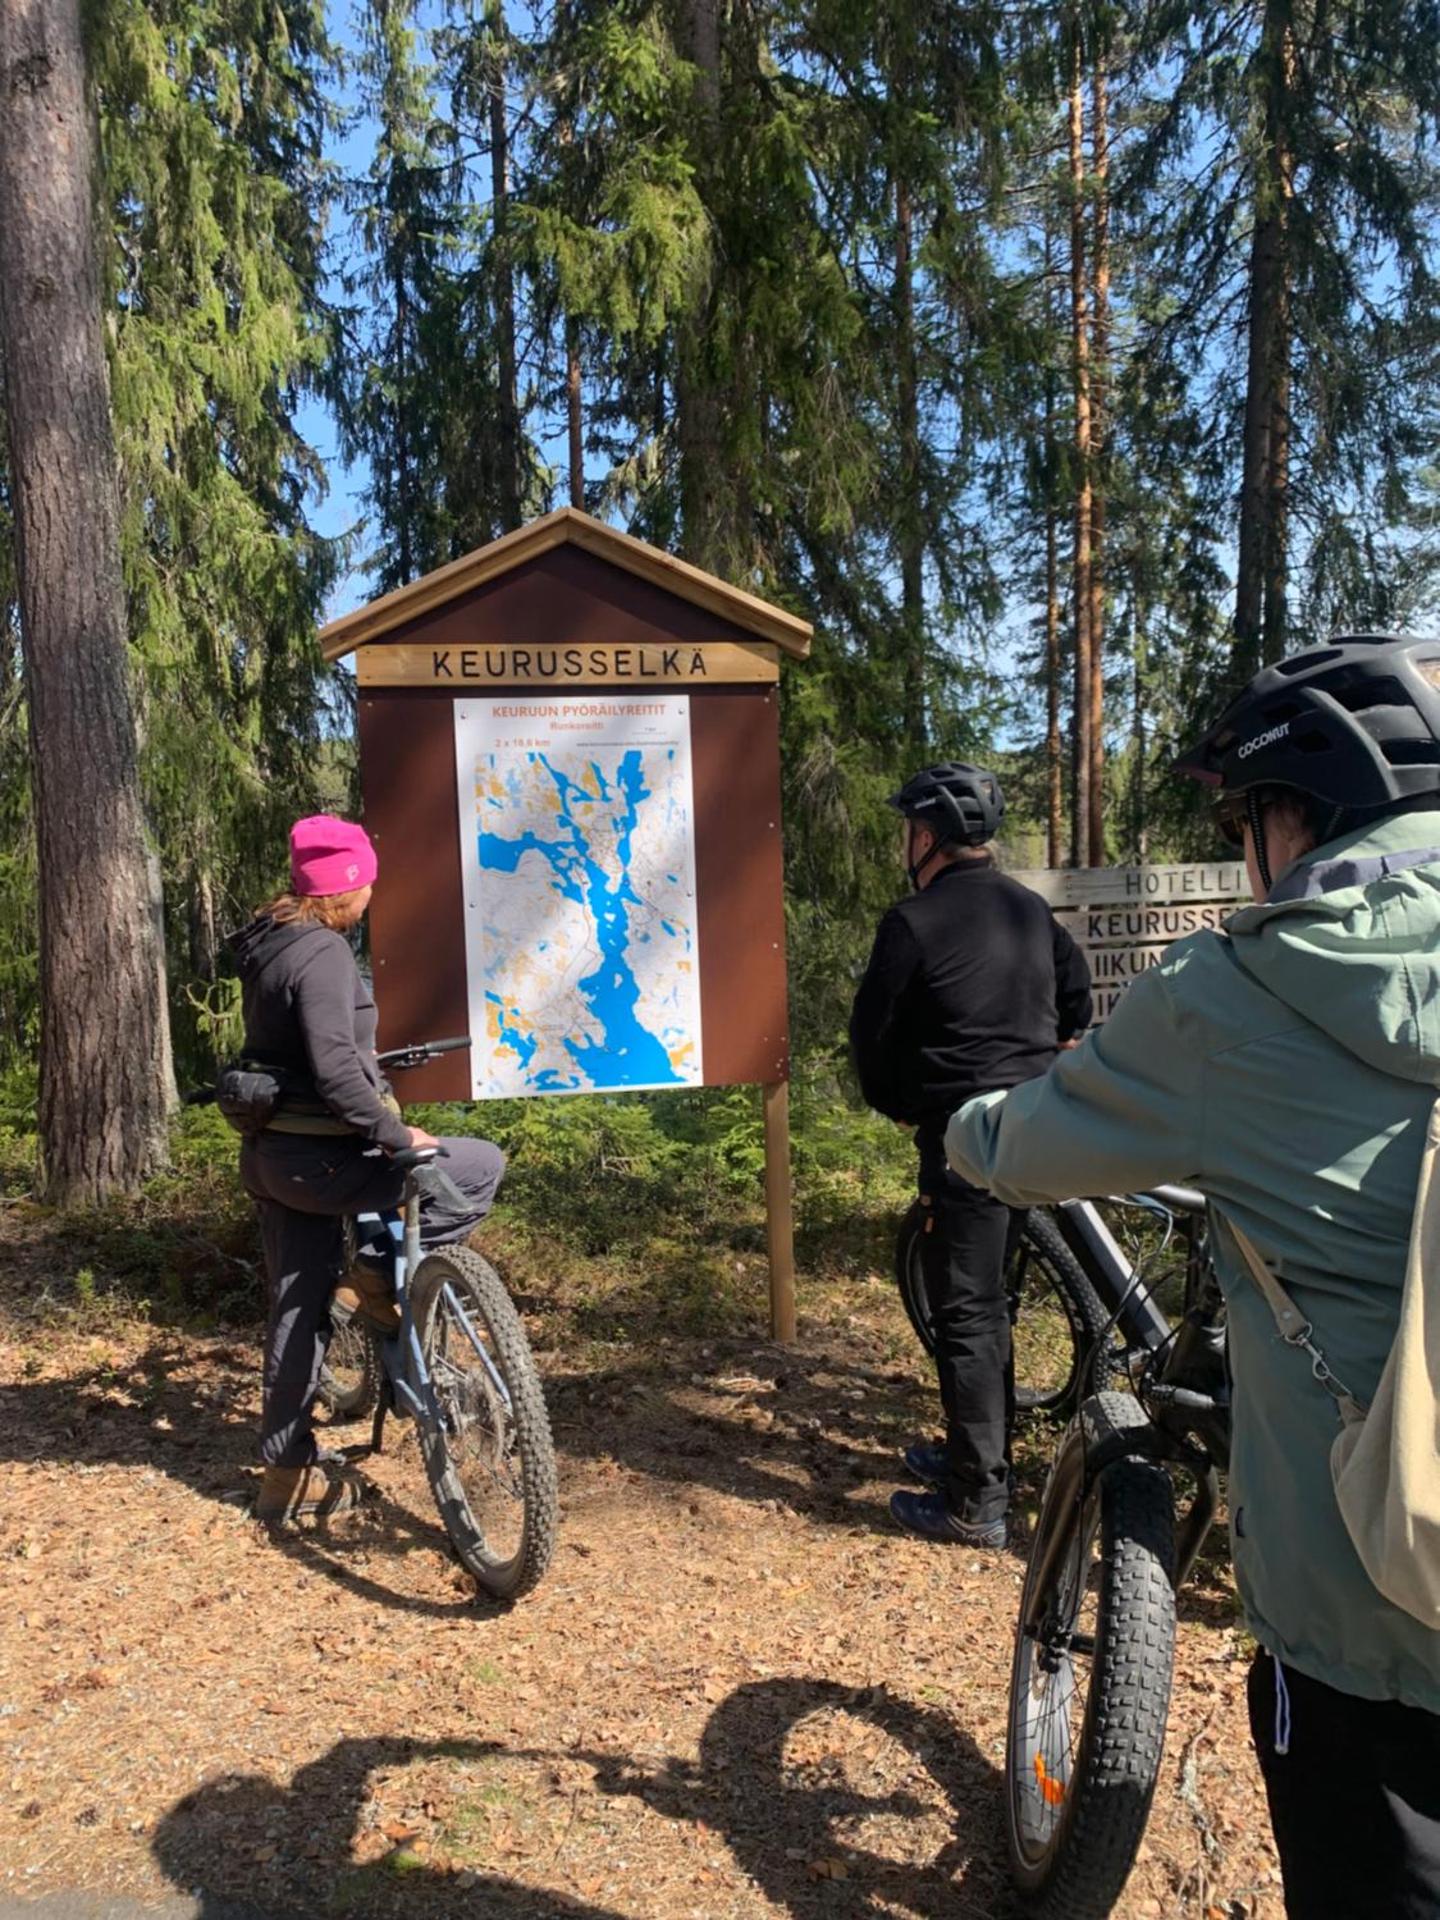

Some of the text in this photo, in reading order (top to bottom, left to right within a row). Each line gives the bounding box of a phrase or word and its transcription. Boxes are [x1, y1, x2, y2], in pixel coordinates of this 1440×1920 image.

[432, 648, 708, 678] KEURUSSELKÄ
[492, 703, 666, 718] KEURUUN PYÖRÄILYREITIT
[1238, 722, 1290, 759] COCONUT
[1126, 869, 1241, 895] HOTELLI
